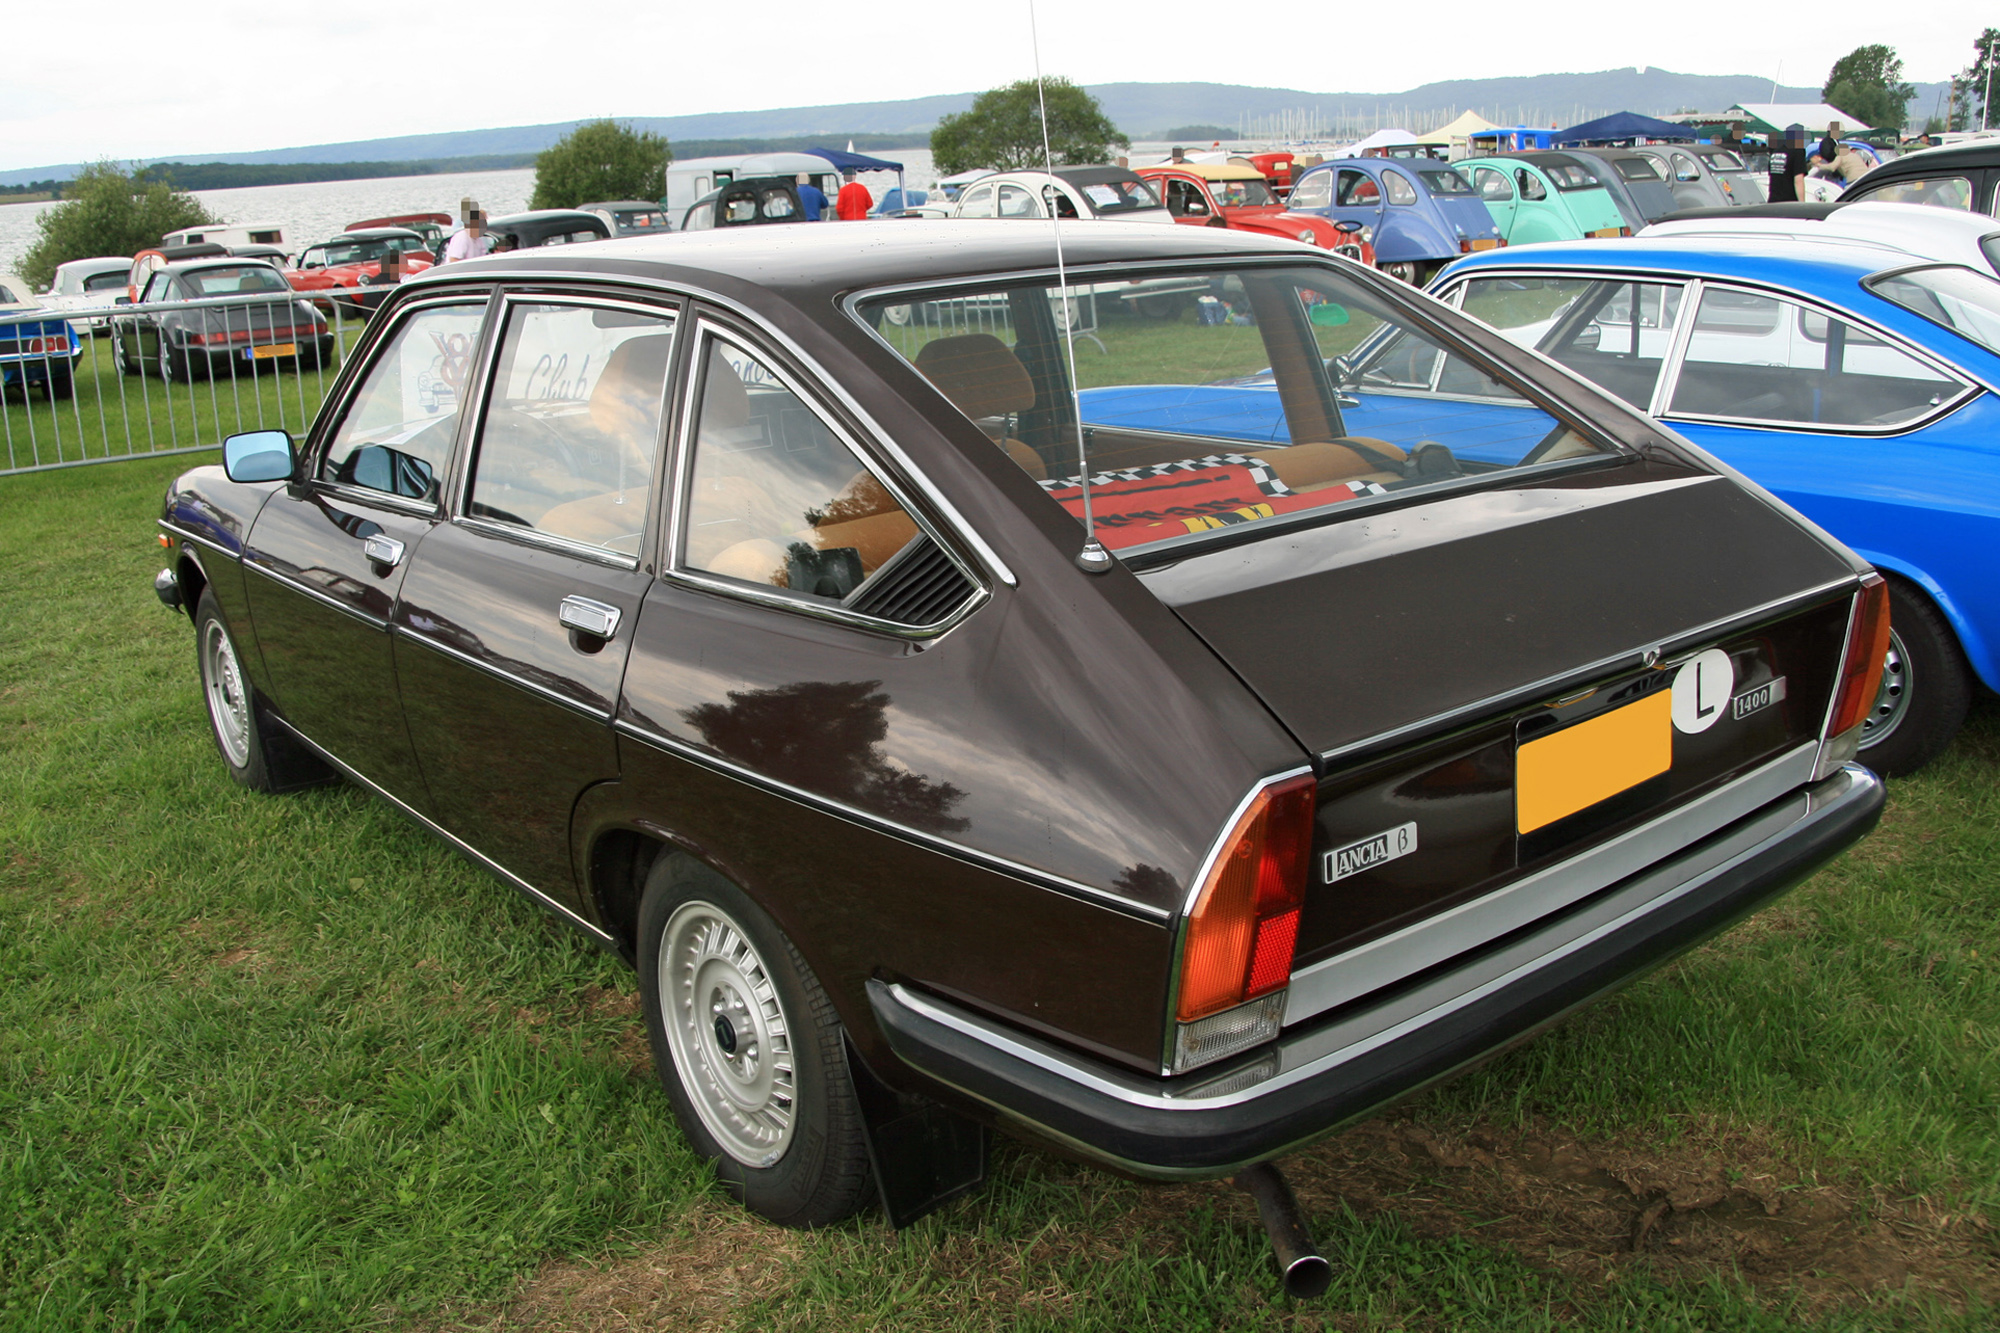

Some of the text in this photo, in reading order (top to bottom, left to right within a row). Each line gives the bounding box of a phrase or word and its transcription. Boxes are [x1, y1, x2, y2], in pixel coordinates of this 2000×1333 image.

[525, 353, 590, 400] Club
[1696, 661, 1715, 720] L
[1738, 689, 1768, 716] 1400
[1330, 838, 1389, 882] LANCIA
